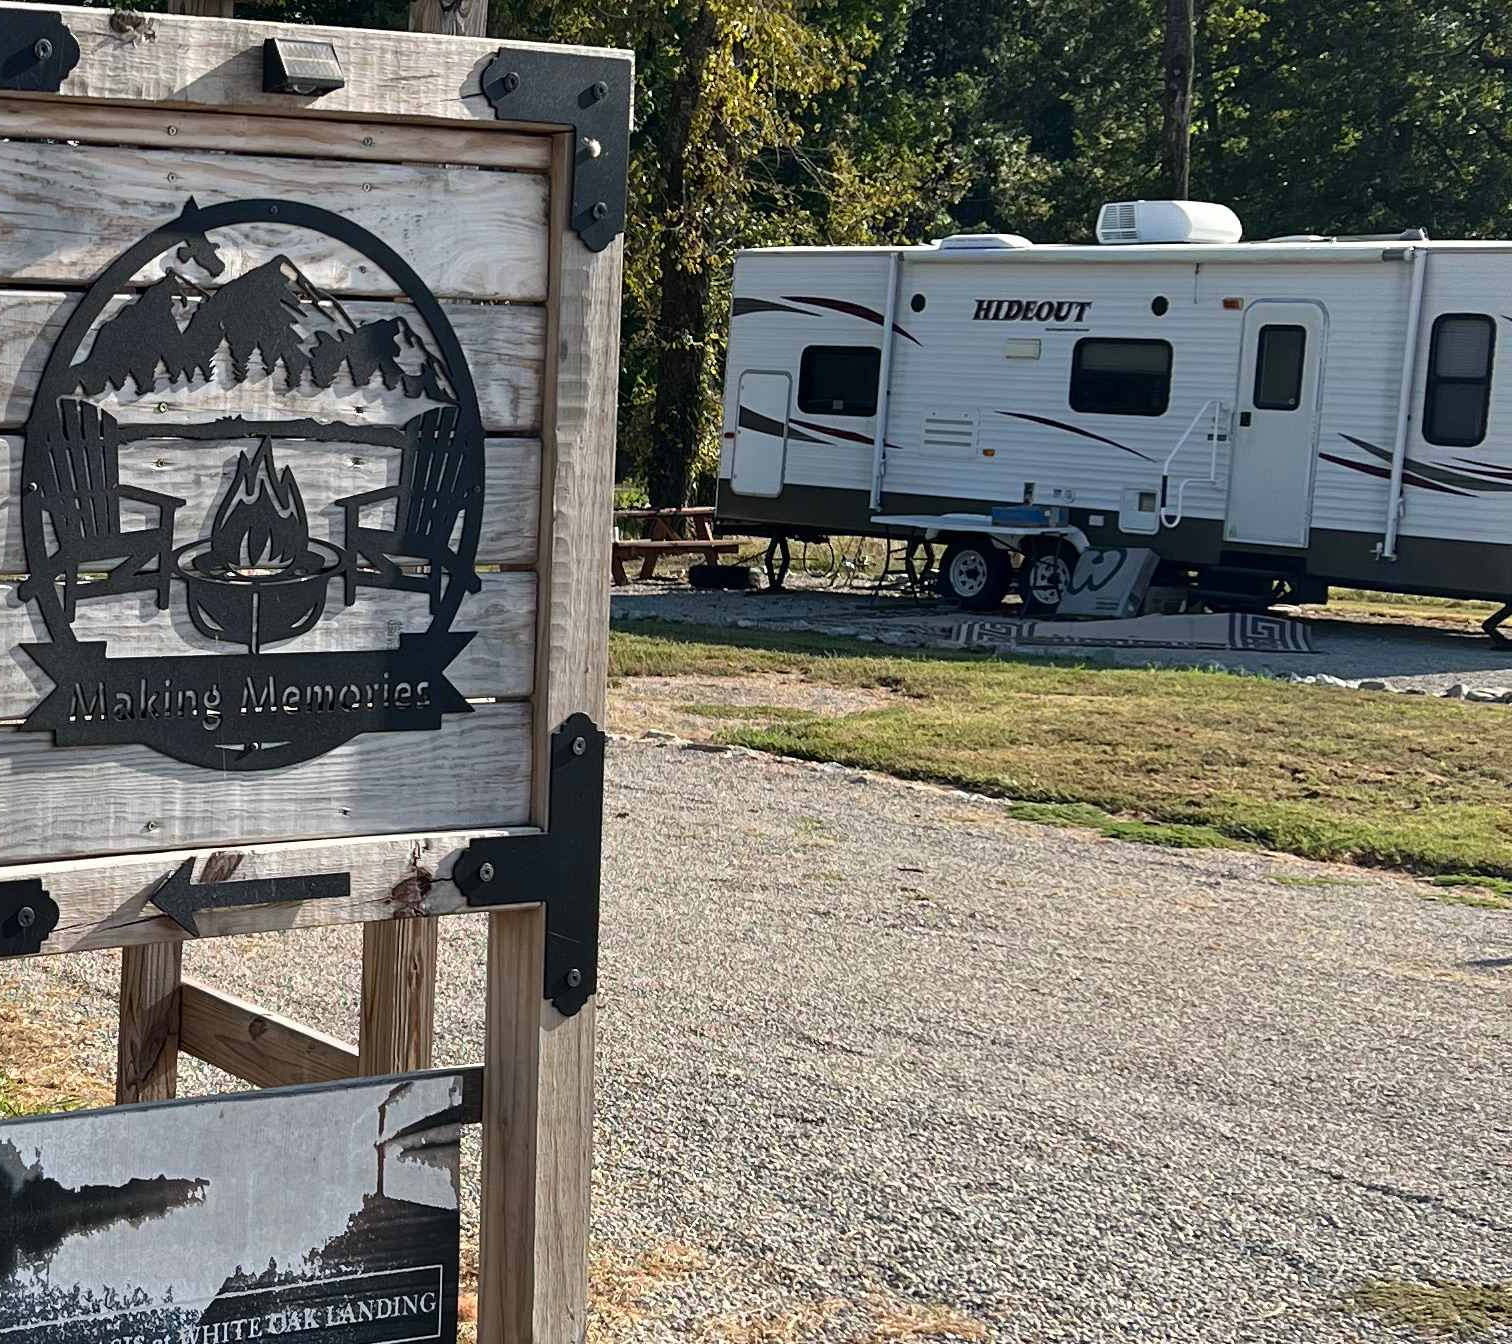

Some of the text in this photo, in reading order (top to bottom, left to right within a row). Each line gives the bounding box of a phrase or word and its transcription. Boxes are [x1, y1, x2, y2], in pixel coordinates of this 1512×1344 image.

[971, 299, 1094, 323] HIDEOUT
[65, 672, 432, 731] Making Memories
[267, 1307, 321, 1335] OAK
[325, 1292, 437, 1328] LANDING
